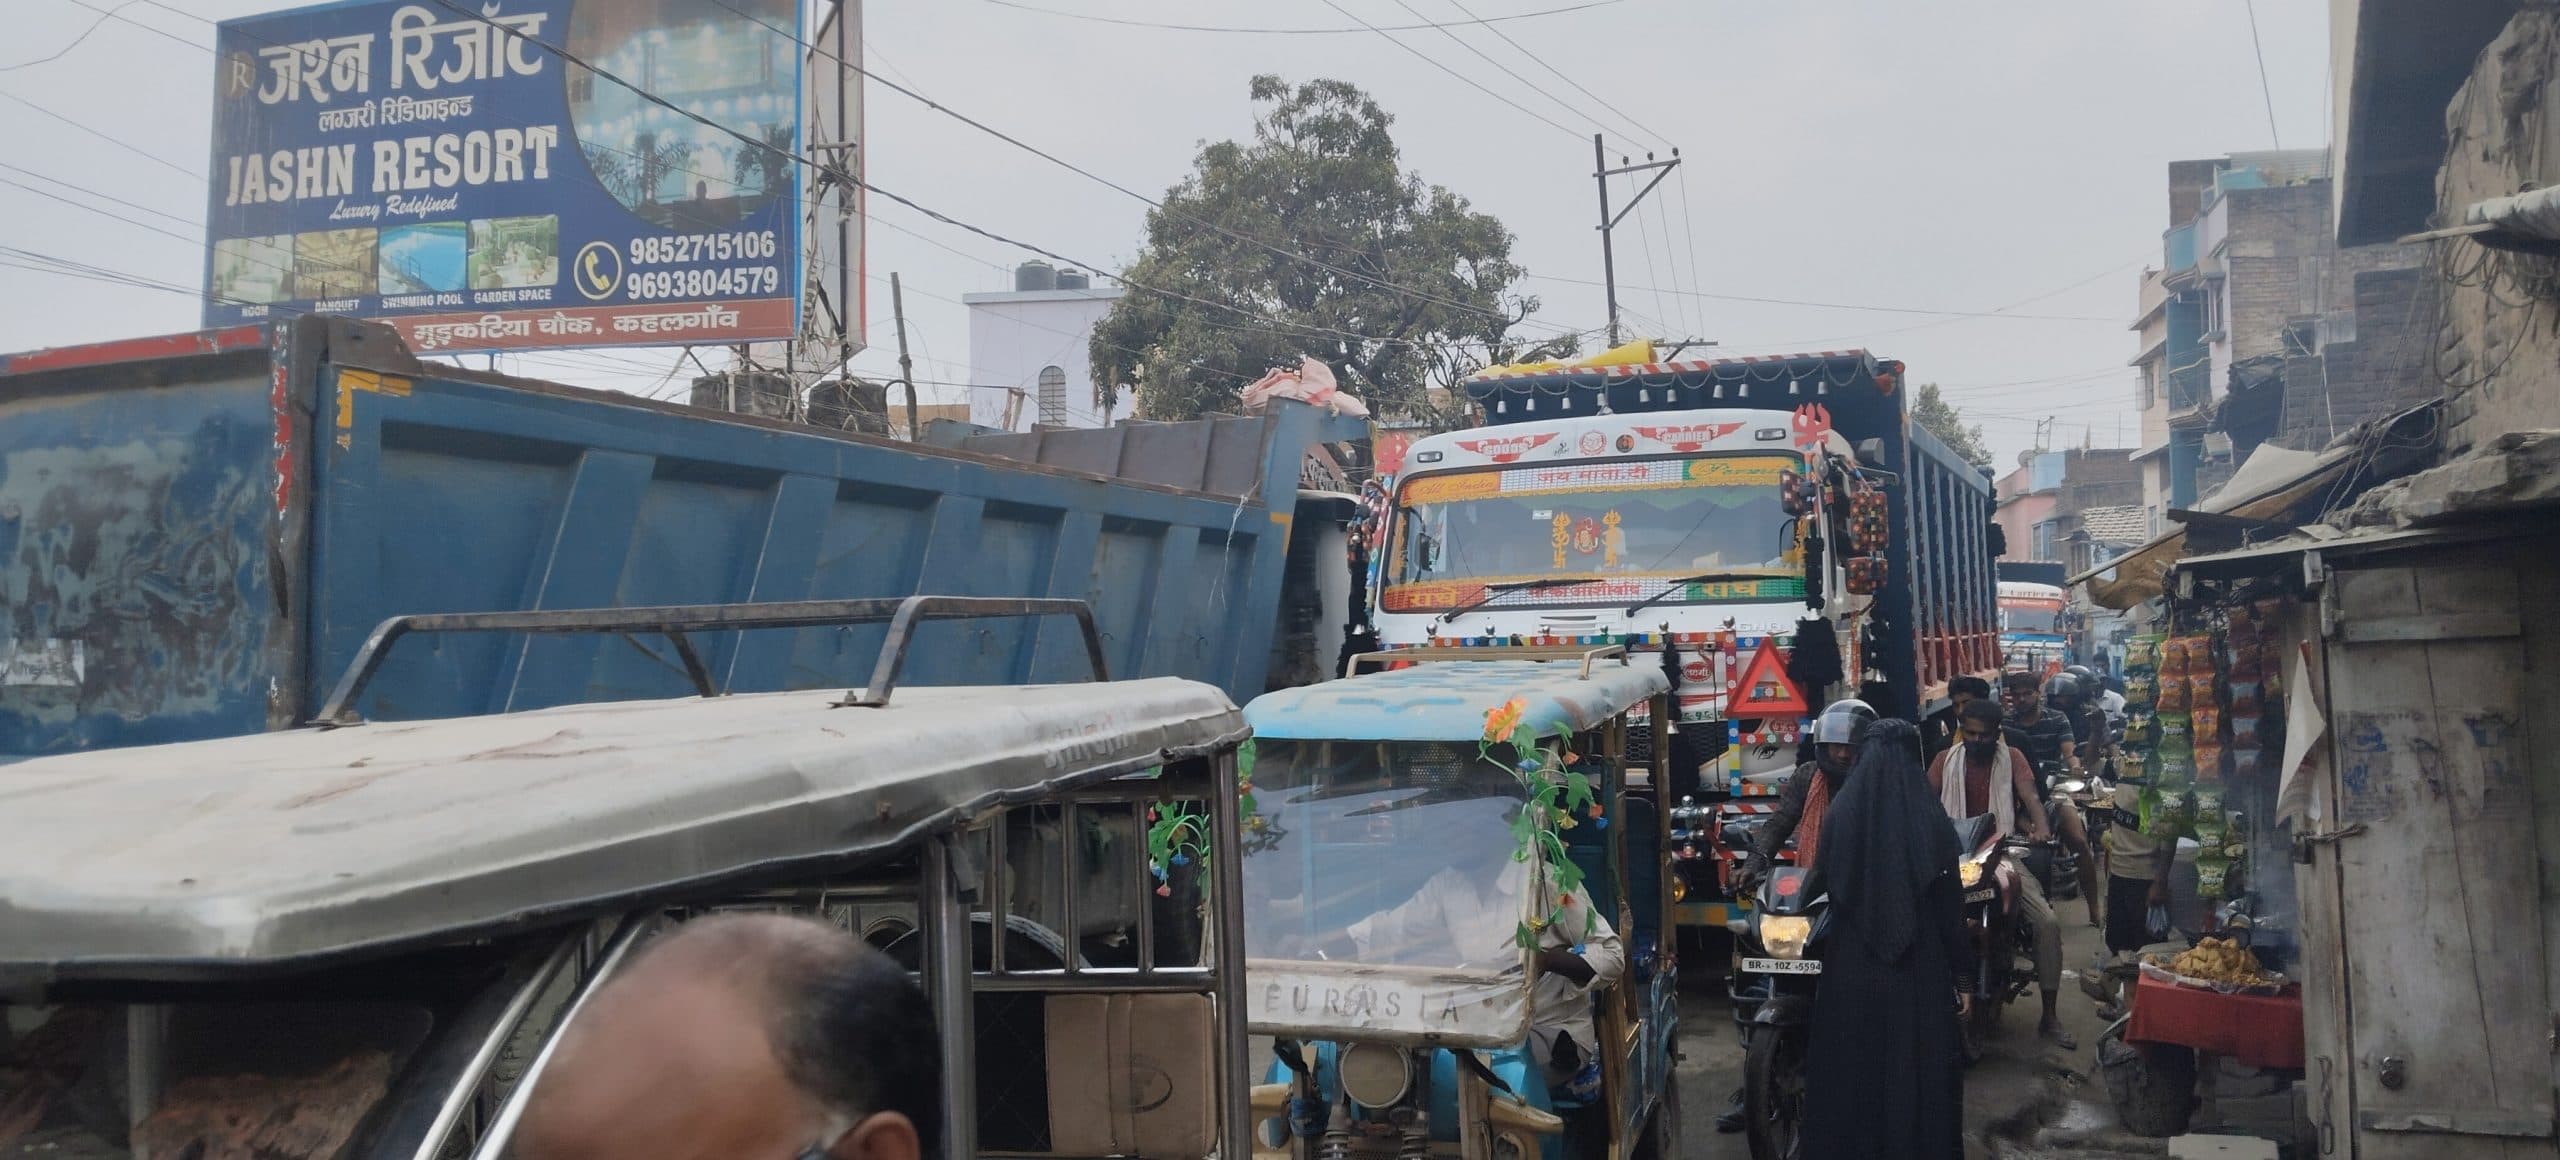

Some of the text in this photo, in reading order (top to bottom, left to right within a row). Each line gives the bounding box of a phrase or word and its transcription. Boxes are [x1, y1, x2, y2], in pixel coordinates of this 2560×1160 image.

[258, 33, 374, 104] जश्न
[226, 125, 558, 206] JASHN RESORT
[329, 192, 459, 221] Luxury Redefined
[630, 230, 776, 265] 9852715106
[474, 288, 552, 303] GARDEN SPACE
[627, 266, 778, 300] 9693804579
[381, 294, 464, 309] SWIMMING POOL
[613, 304, 740, 333] कहलगाँव
[1264, 984, 1460, 1023] EURASIA
